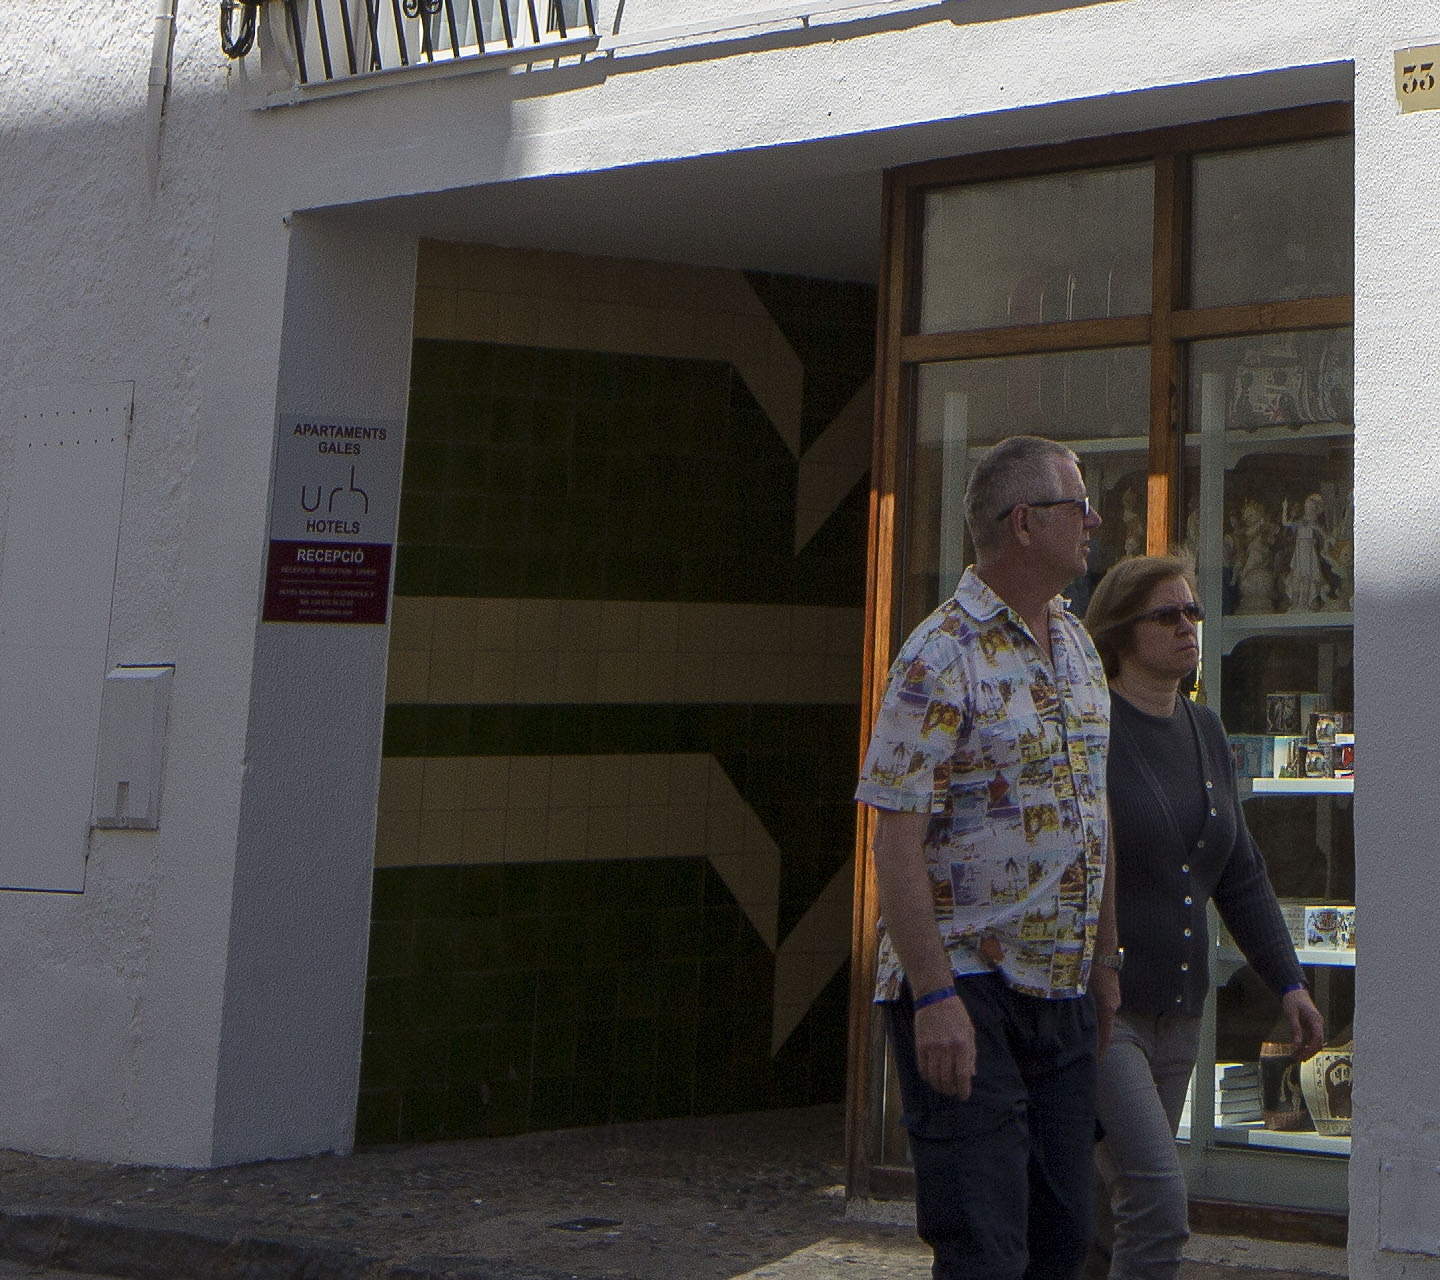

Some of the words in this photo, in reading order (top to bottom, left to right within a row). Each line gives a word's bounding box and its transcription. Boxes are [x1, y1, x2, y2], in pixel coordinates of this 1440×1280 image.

[293, 423, 388, 441] APARTAMENTS
[318, 441, 361, 455] GALES
[306, 520, 360, 535] HOTELS
[297, 547, 365, 564] RECEPCIÓ
